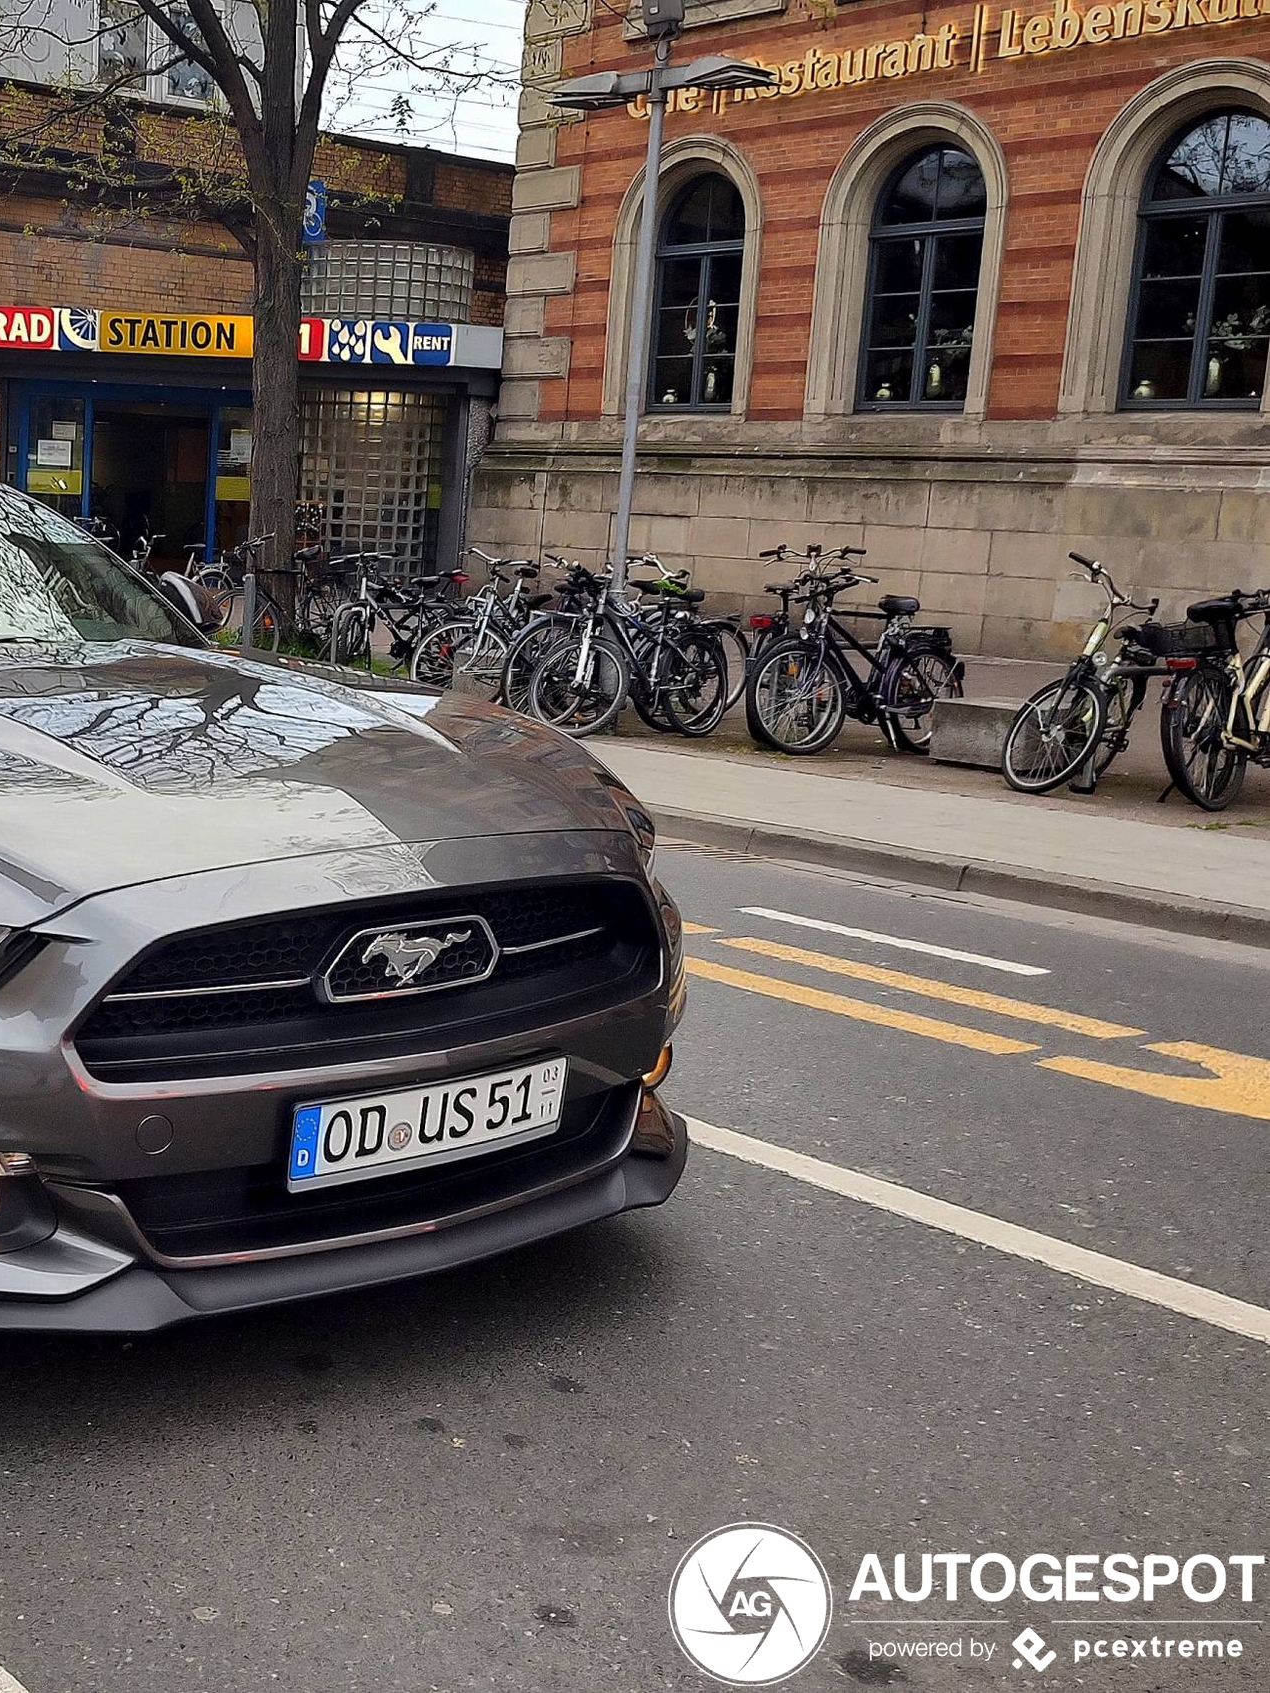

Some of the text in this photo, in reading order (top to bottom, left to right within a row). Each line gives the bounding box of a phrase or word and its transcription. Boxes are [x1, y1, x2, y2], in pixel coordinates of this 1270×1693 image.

[108, 317, 235, 350] STATION
[413, 336, 450, 350] RENT
[542, 1066, 559, 1083] 03
[323, 1074, 533, 1164] OD US 51
[296, 1149, 309, 1168] D
